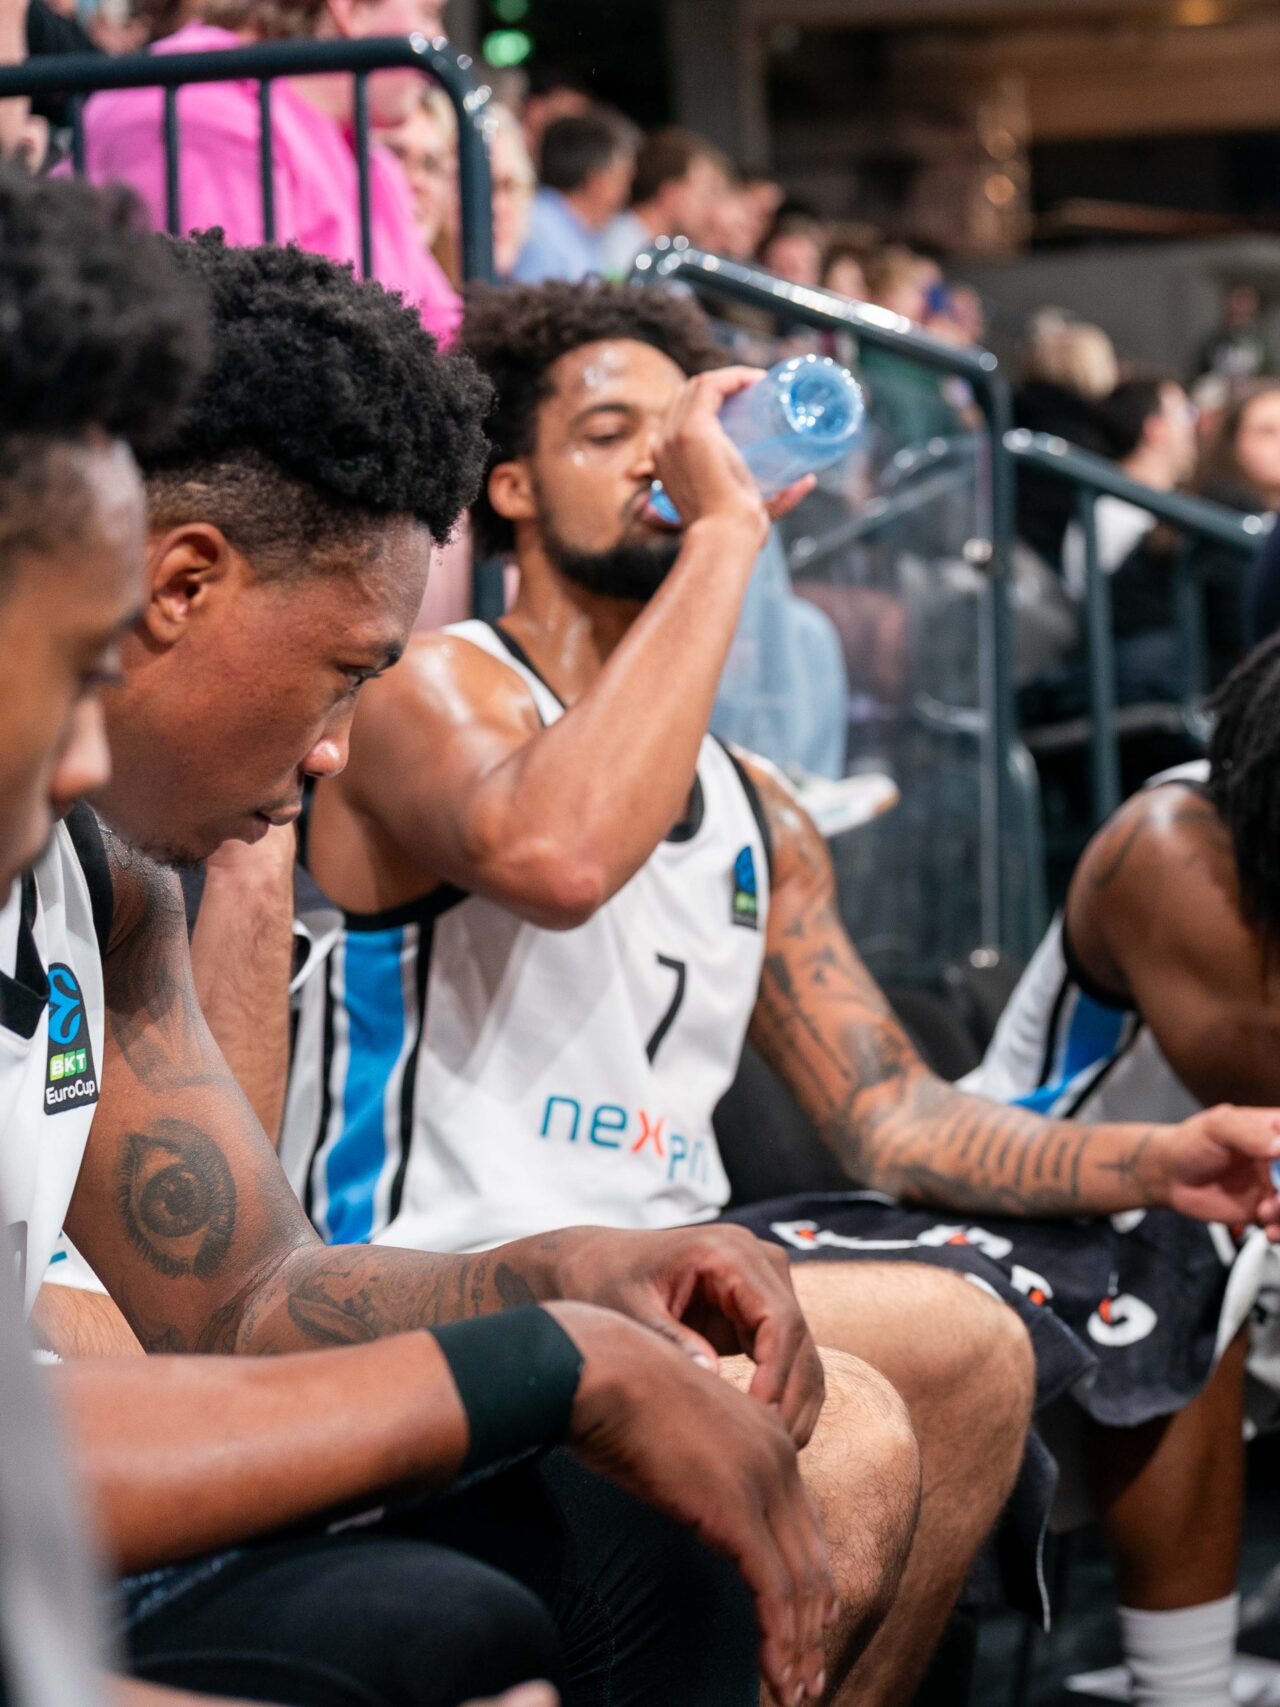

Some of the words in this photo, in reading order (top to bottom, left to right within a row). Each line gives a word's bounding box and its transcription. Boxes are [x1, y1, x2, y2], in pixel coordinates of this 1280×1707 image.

[646, 952, 687, 1068] 7
[51, 1053, 87, 1077] BKT
[46, 1079, 95, 1105] EuroCup
